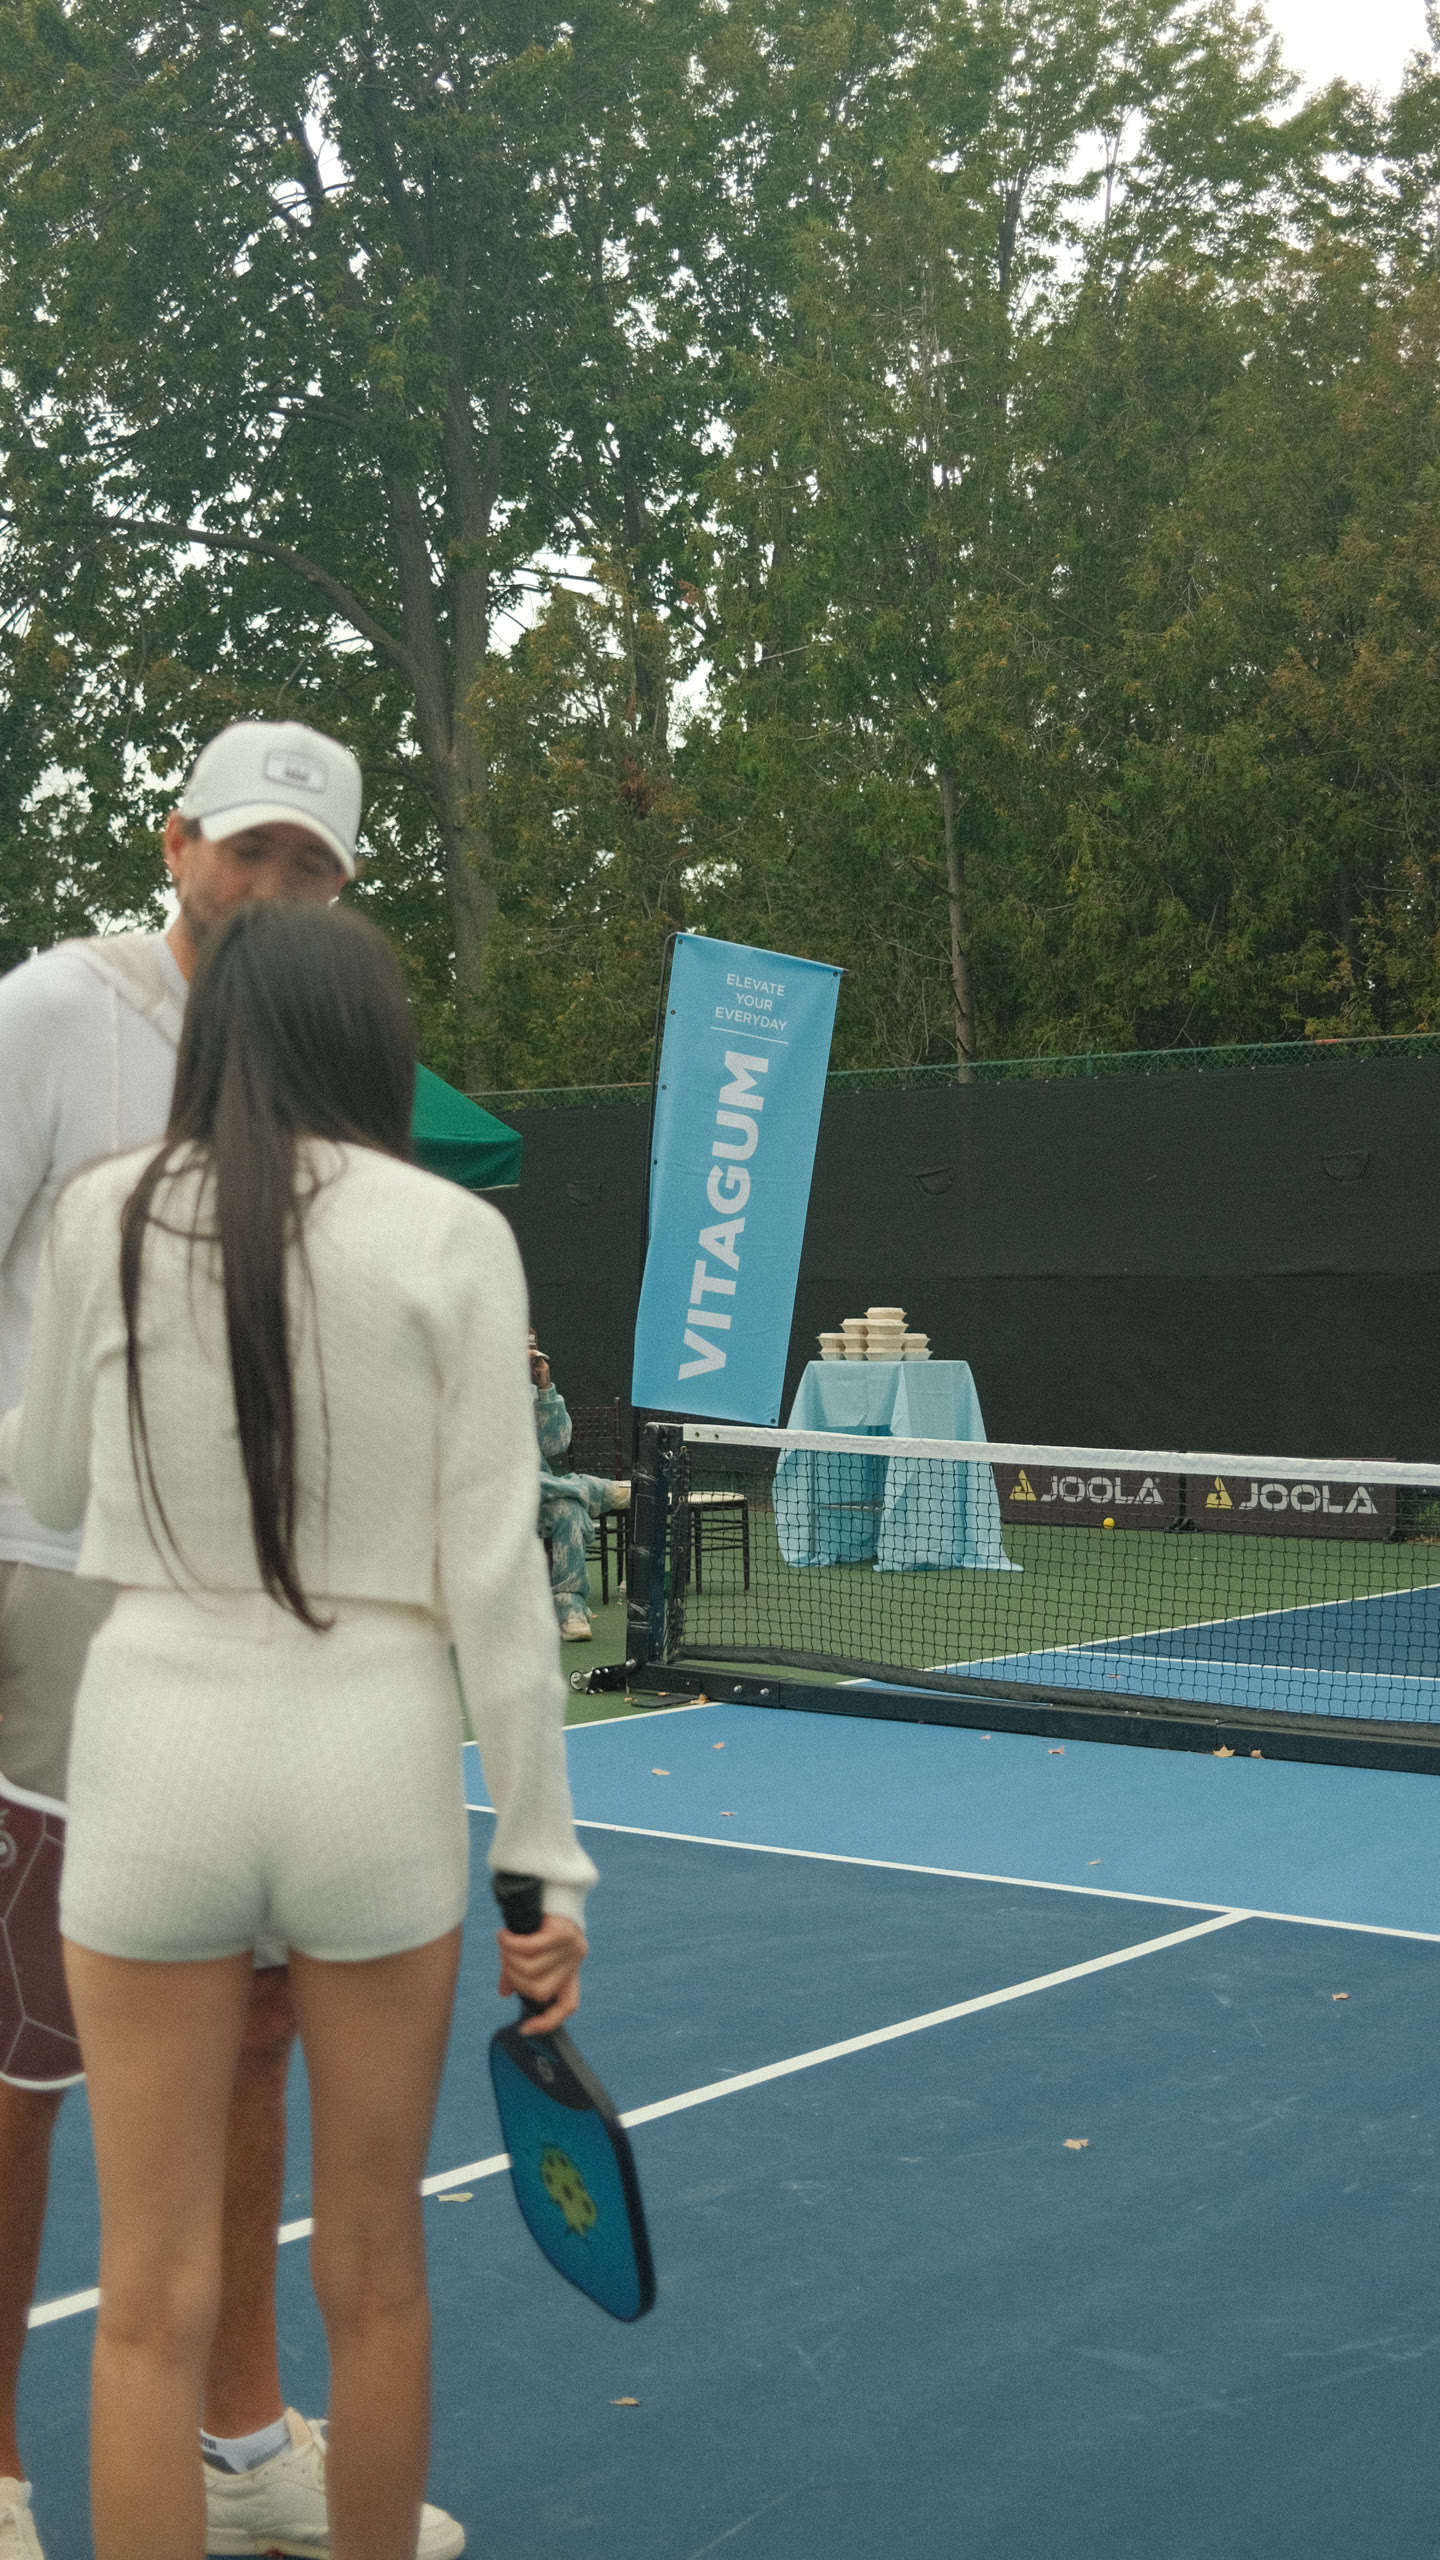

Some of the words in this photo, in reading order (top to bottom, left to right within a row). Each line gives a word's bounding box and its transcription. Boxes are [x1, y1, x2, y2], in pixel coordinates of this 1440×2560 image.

[726, 973, 785, 997] ELEVATE
[735, 992, 773, 1011] YOUR
[715, 1006, 787, 1031] EVERYDAY
[678, 1050, 769, 1381] VITAGUM
[1040, 1475, 1164, 1505] JOOLA
[1238, 1483, 1378, 1515] JOOLA
